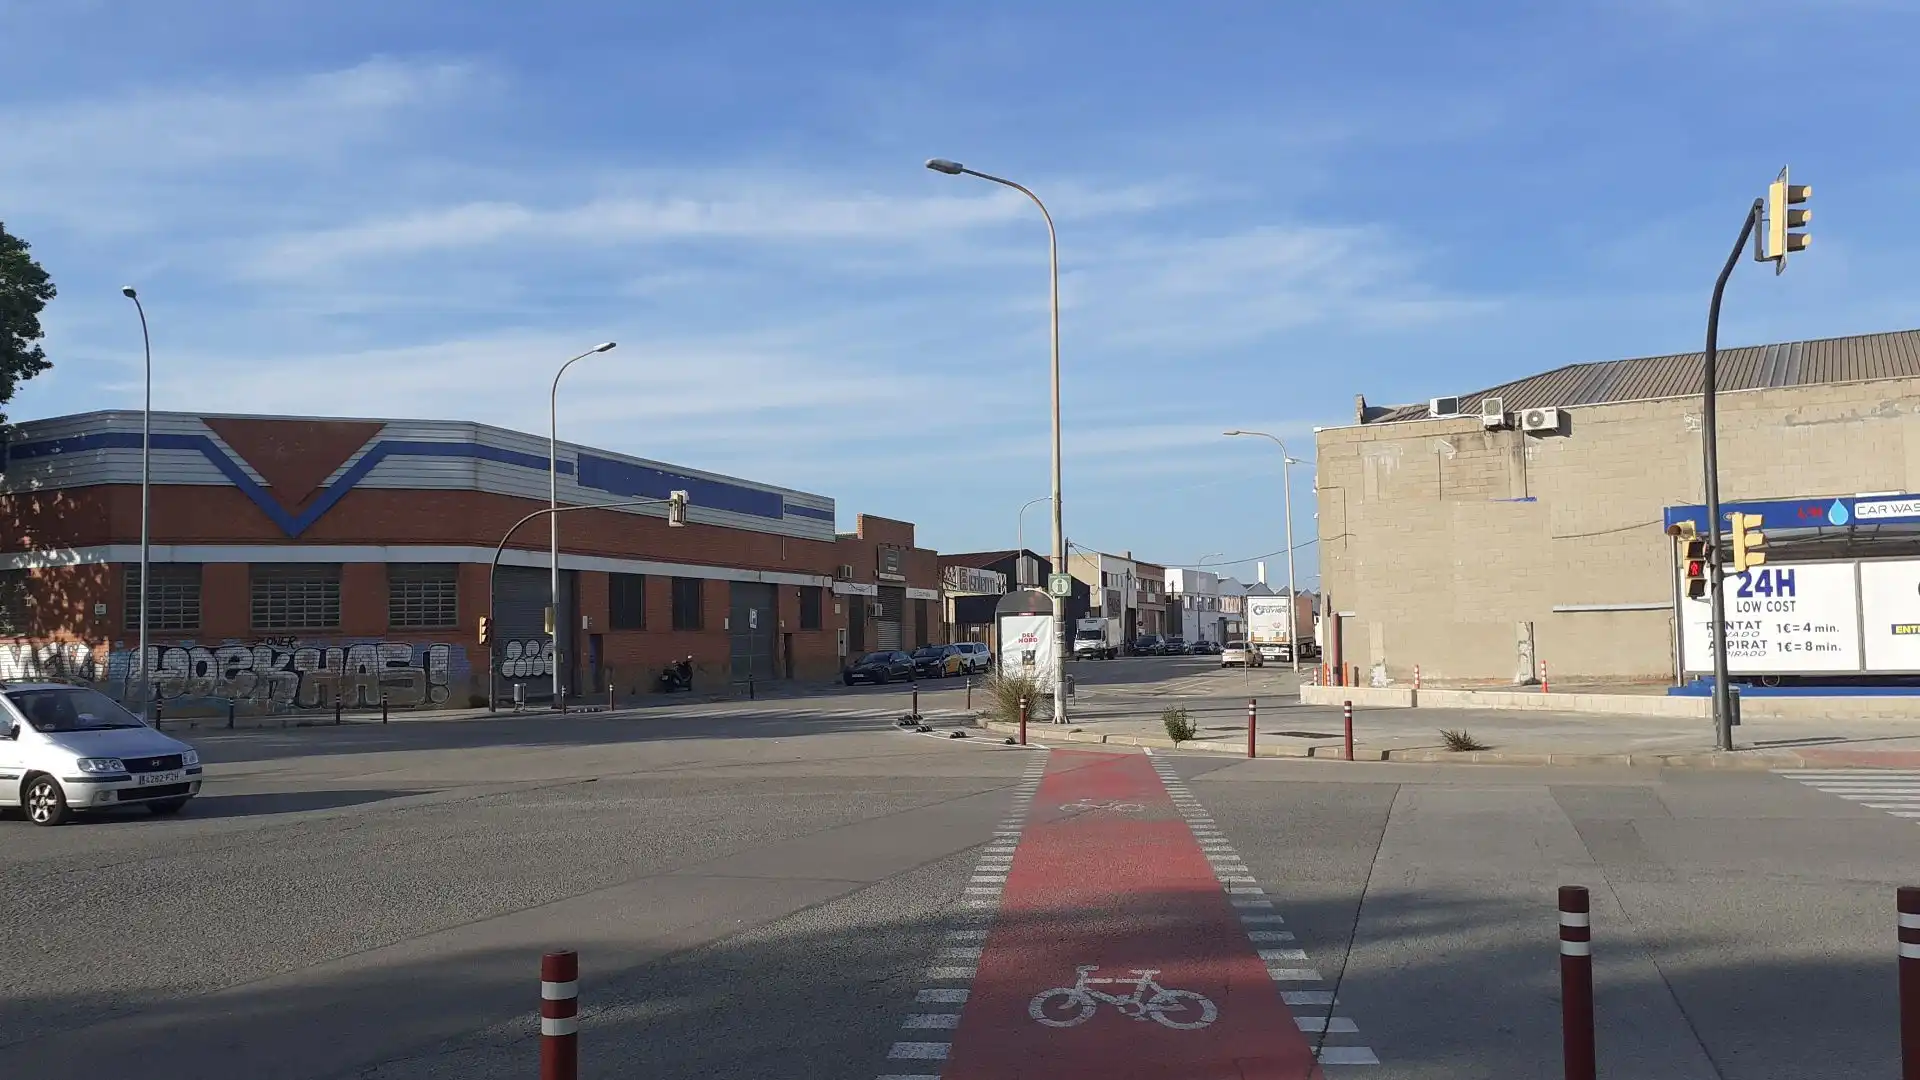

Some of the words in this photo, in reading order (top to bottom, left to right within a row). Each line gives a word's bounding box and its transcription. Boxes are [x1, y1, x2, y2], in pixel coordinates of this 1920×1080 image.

[1857, 504, 1888, 516] CAR
[1736, 568, 1796, 598] 24H
[1736, 601, 1762, 613] LOW
[1766, 600, 1796, 612] COST
[1706, 620, 1762, 631] RNTAT
[1803, 622, 1811, 632] 4
[1814, 623, 1840, 633] min.
[1708, 640, 1768, 650] APIRAT
[1805, 641, 1812, 651] 8
[1815, 642, 1842, 652] min.
